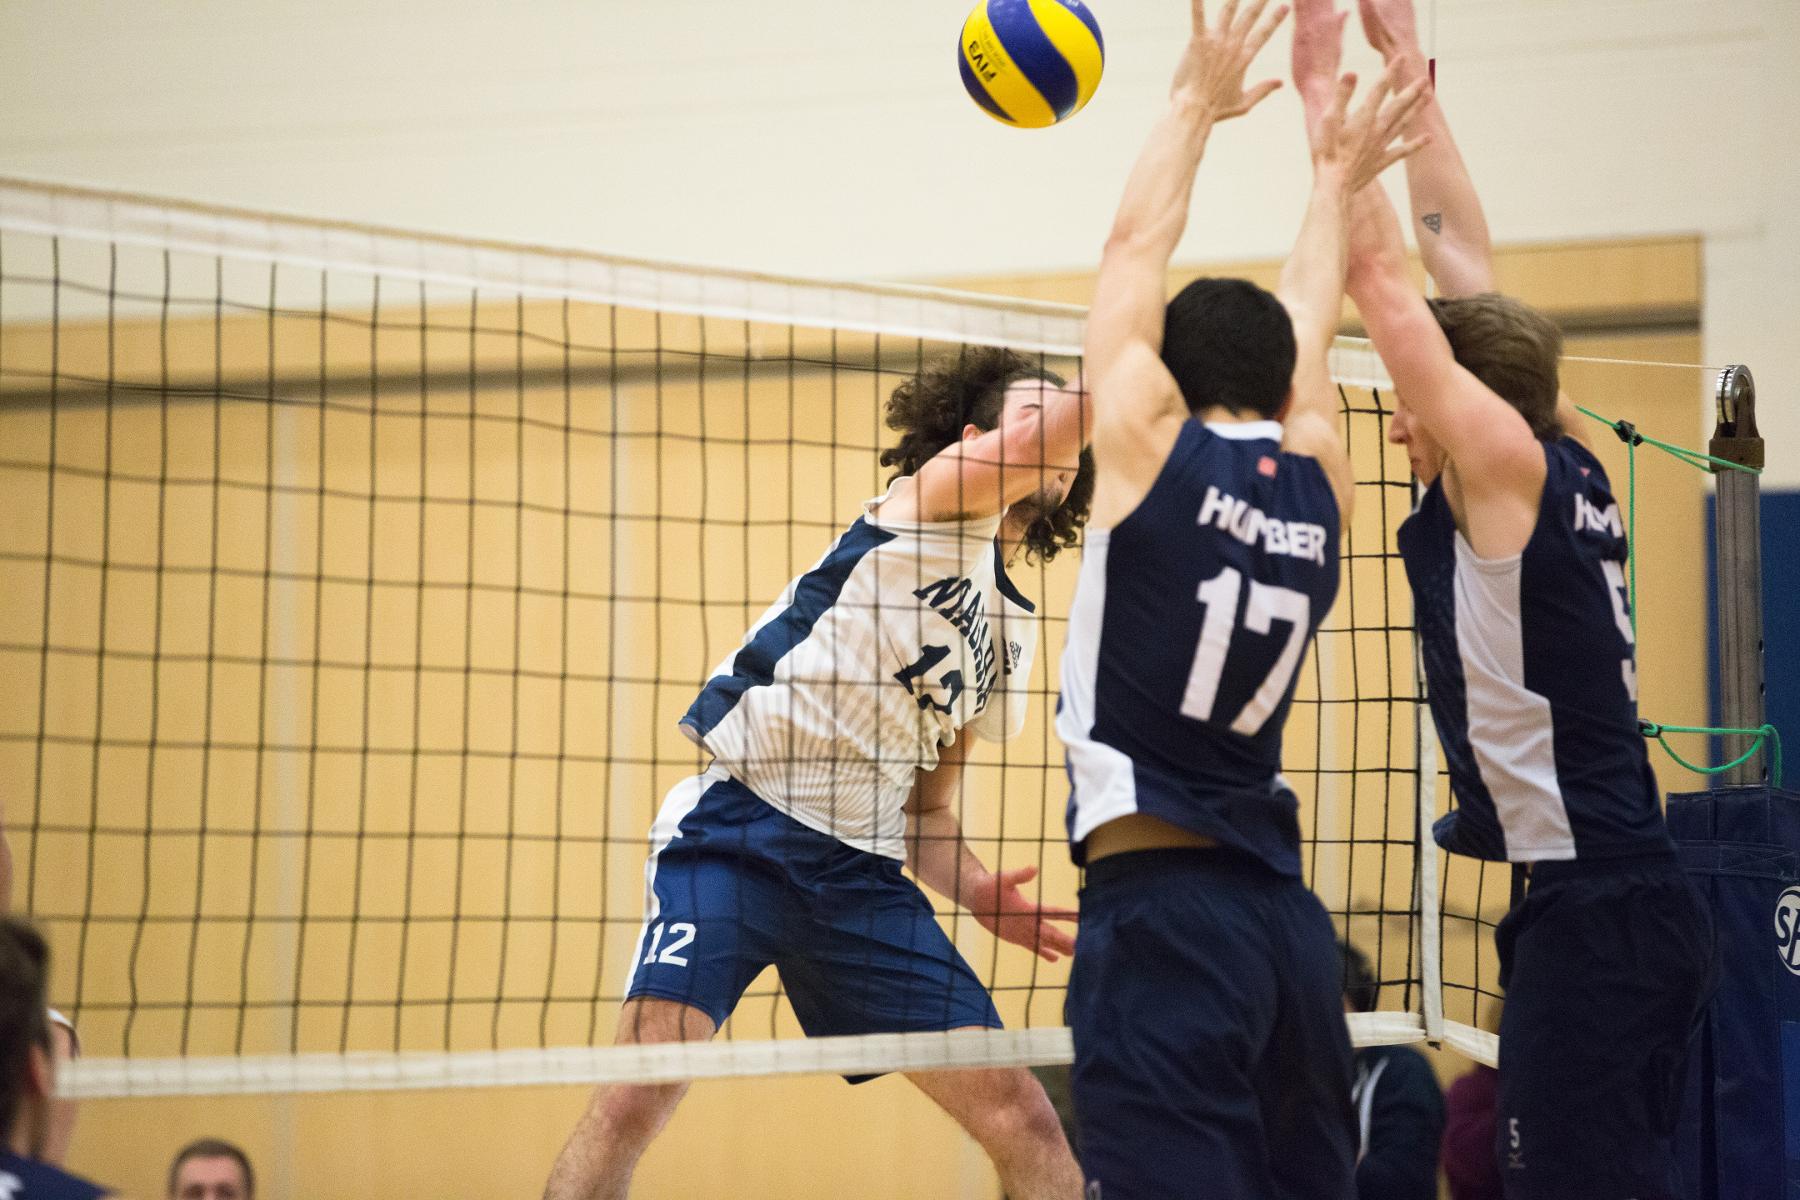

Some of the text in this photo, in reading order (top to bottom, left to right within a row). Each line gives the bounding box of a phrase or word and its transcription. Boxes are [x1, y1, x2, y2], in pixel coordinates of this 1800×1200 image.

[1197, 485, 1327, 567] HUMBER
[1179, 566, 1311, 736] 17
[643, 922, 697, 967] 12
[1509, 1117, 1521, 1149] 5
